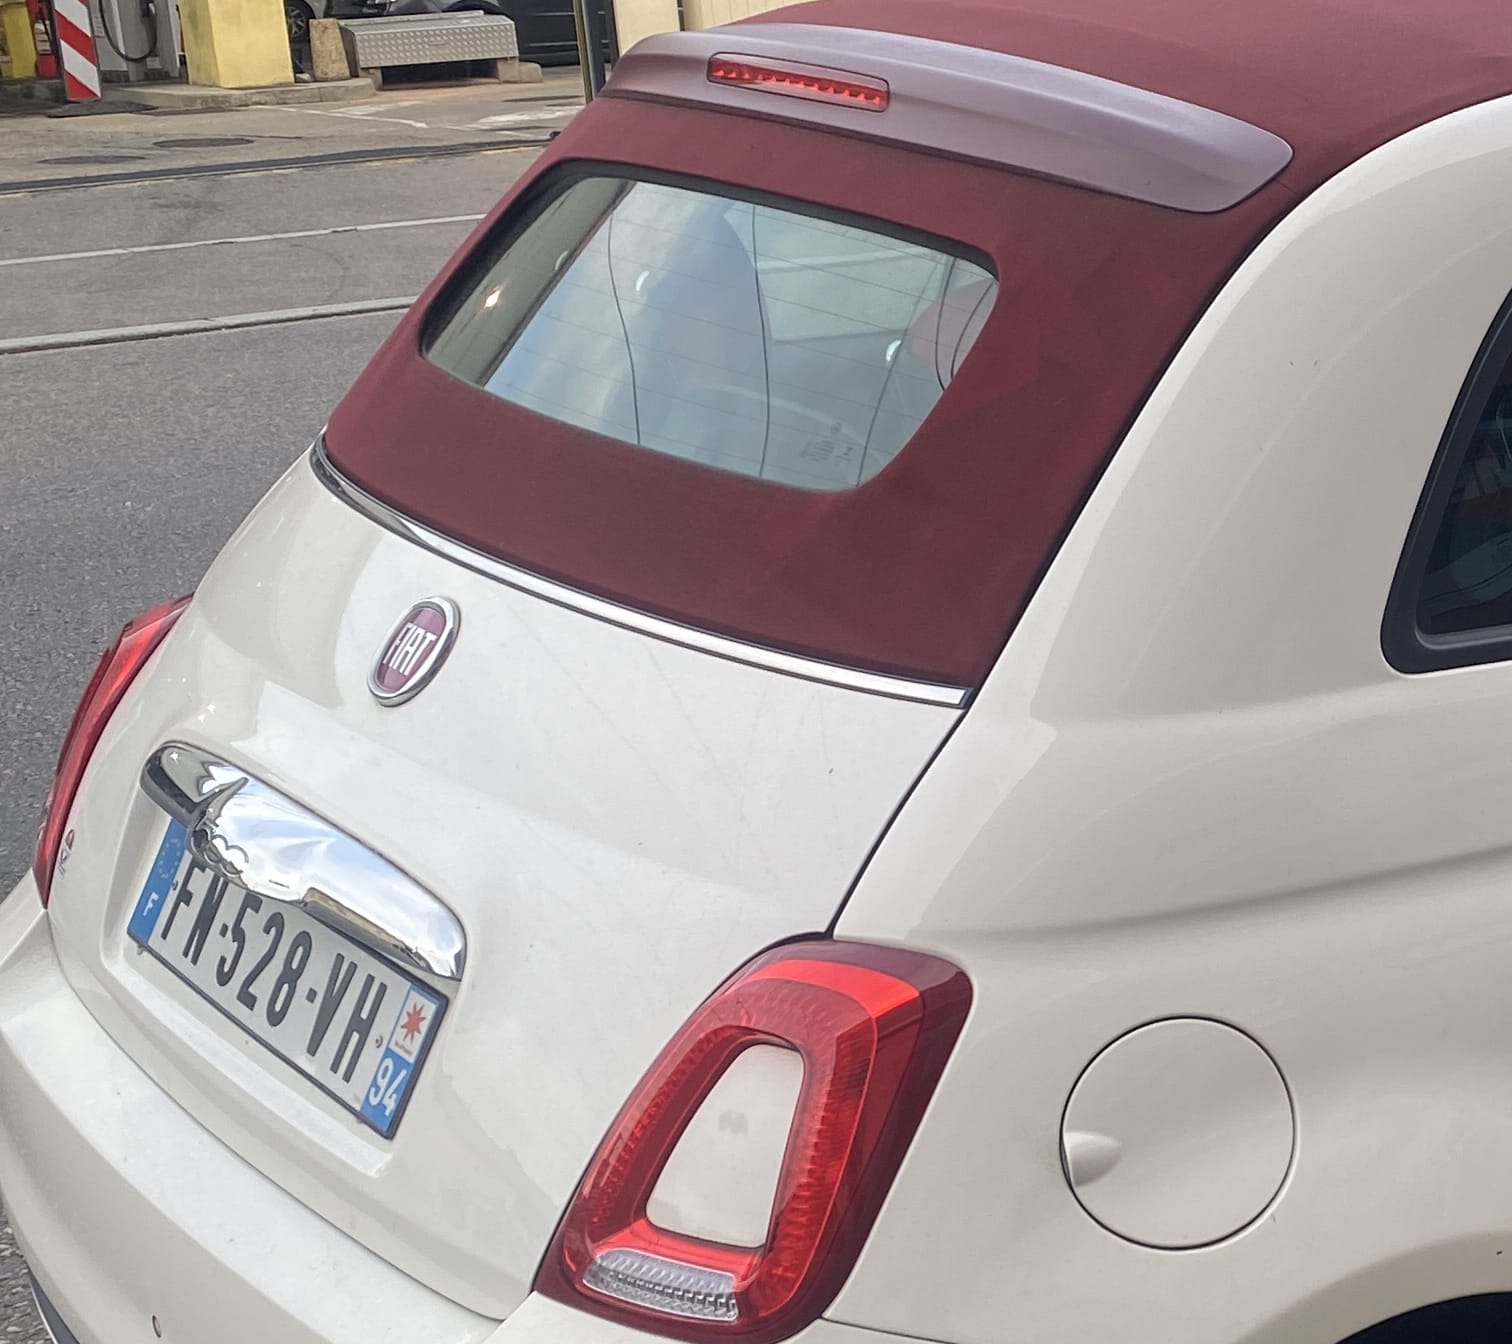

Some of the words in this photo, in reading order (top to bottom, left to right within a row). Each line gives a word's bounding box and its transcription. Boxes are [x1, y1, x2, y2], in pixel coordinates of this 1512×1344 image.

[382, 622, 439, 676] FIAT
[143, 892, 160, 916] F
[367, 1058, 407, 1117] 94
